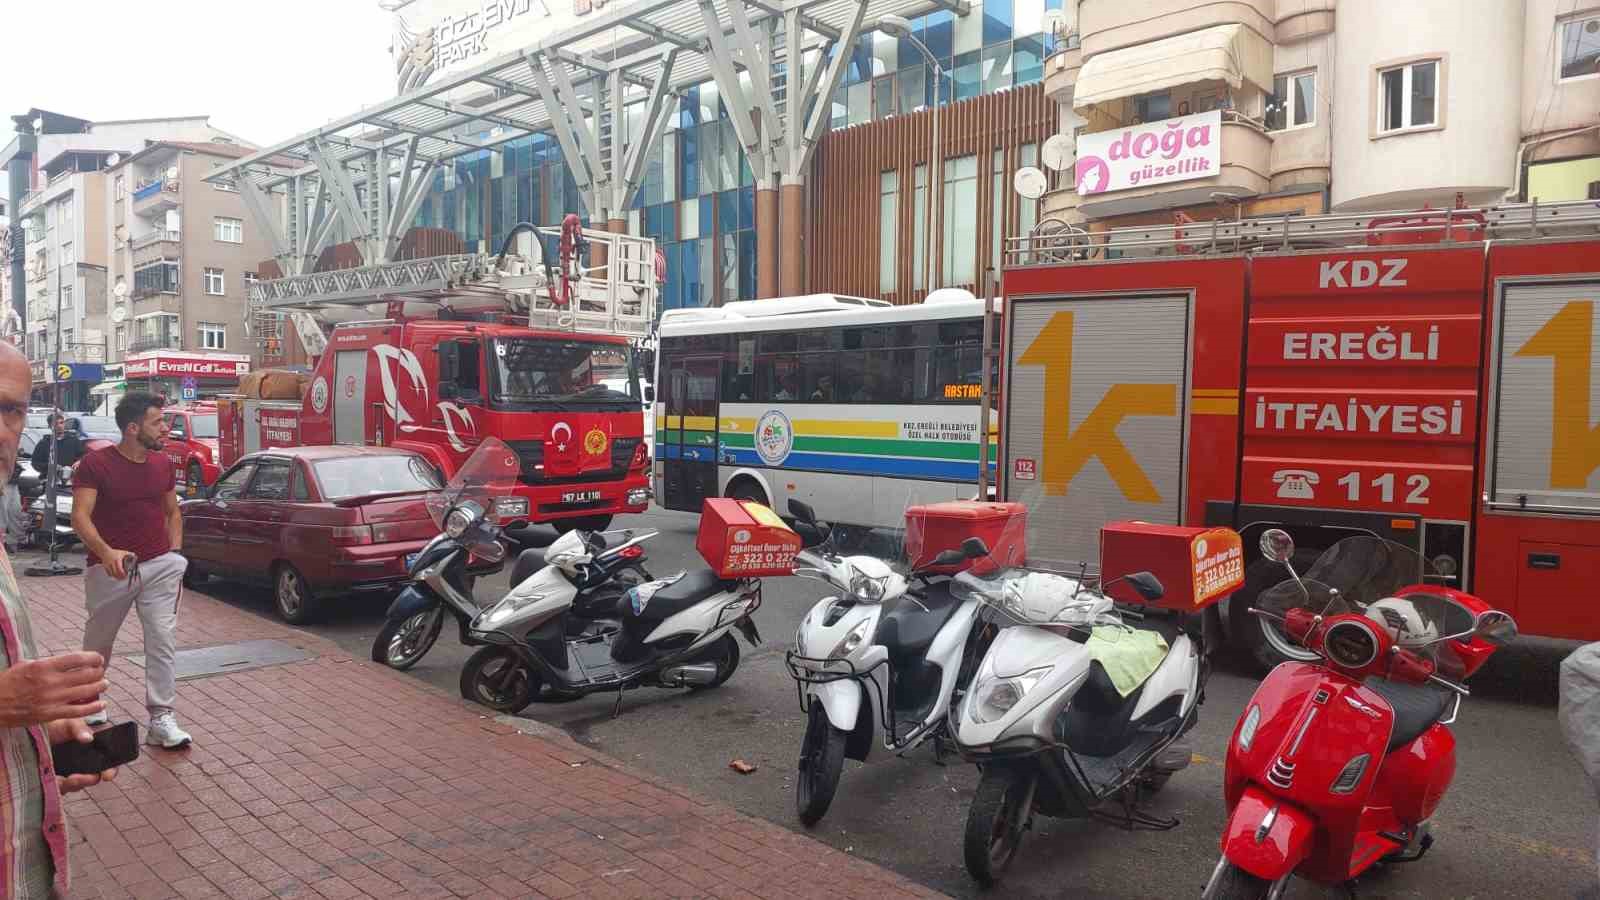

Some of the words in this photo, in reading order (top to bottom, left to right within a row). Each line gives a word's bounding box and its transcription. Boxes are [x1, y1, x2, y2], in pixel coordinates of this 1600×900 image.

[437, 31, 489, 68] PARK
[1108, 120, 1211, 160] doğa
[1129, 157, 1210, 185] güzellik
[1319, 258, 1408, 289] KDZ
[1283, 325, 1440, 361] EREĞLİ
[1255, 396, 1463, 435] İTFAİYESİ
[1338, 471, 1430, 504] 112
[743, 553, 762, 563] 322
